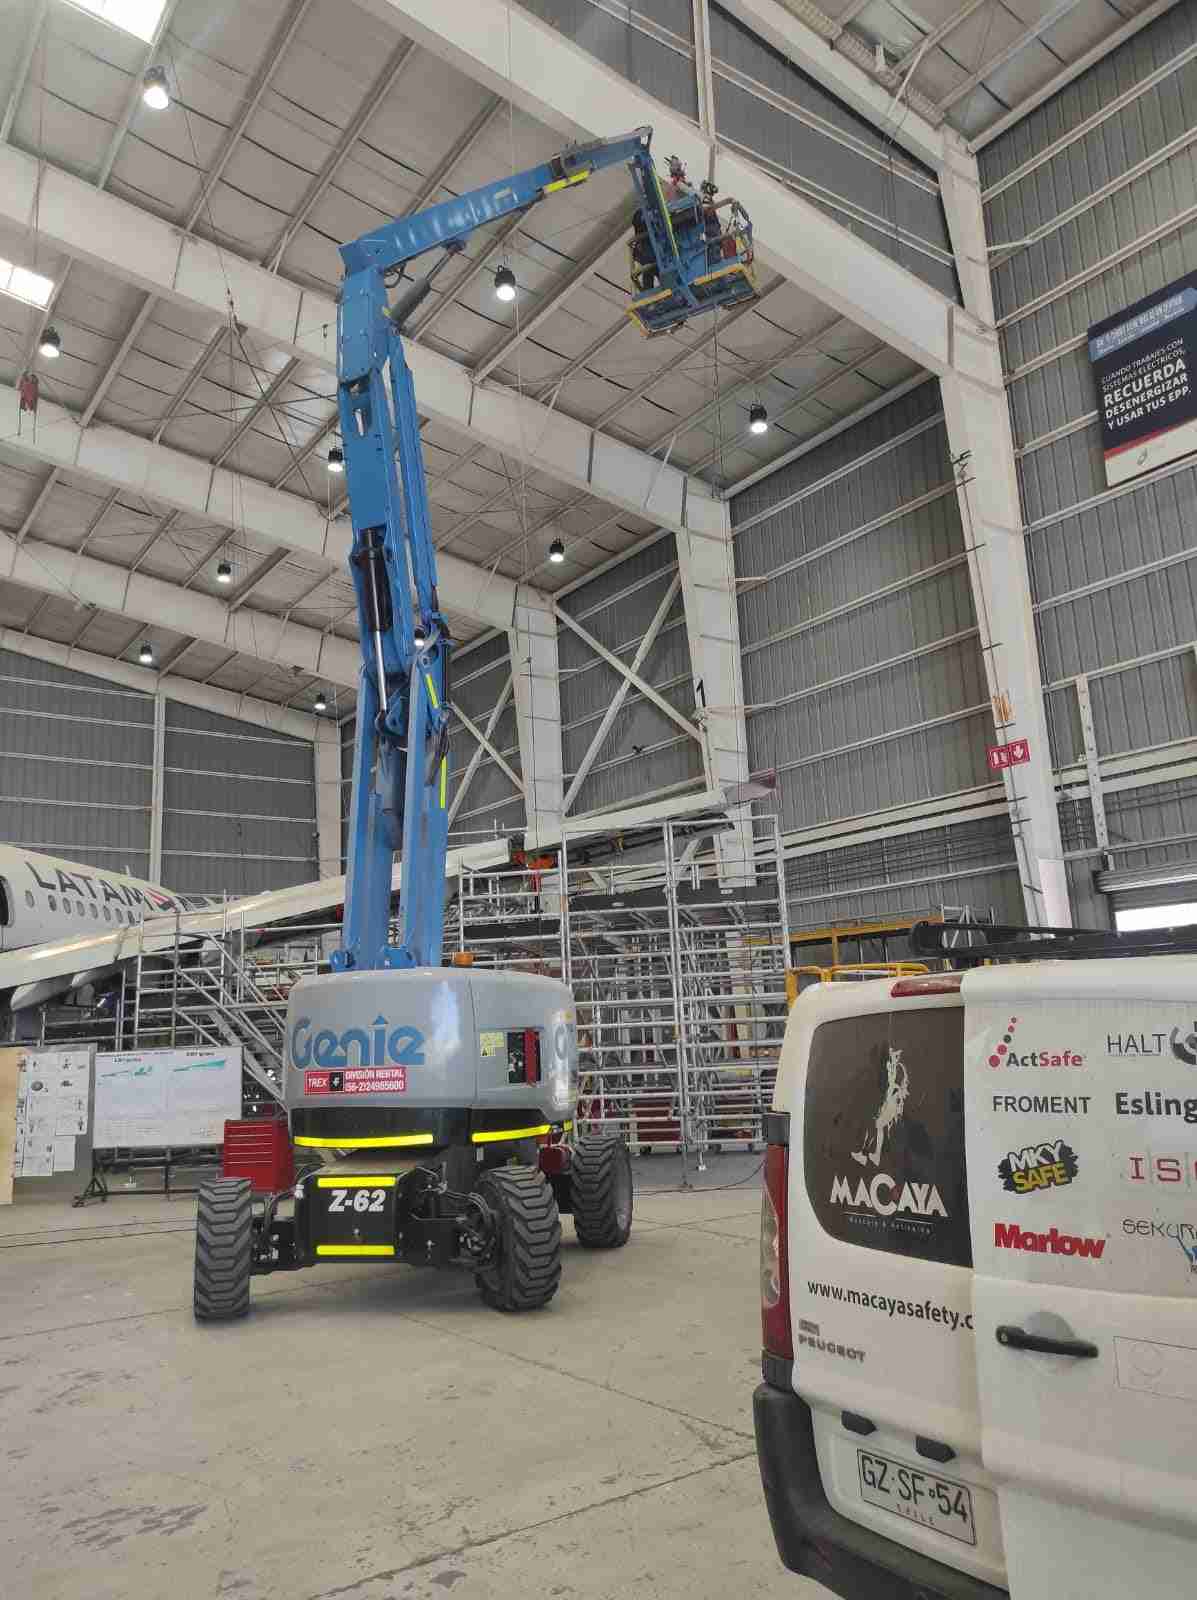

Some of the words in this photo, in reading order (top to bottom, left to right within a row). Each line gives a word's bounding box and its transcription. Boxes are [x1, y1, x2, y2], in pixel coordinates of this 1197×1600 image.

[1166, 337, 1184, 351] CON
[1104, 358, 1186, 407] RECUERDA
[1105, 373, 1188, 419] DESENERGIZAR
[1107, 420, 1114, 430] Y
[1116, 407, 1144, 426] USAR
[1145, 396, 1166, 413] TUS
[1167, 386, 1192, 402] EPP.
[25, 861, 154, 911] LATAM
[292, 1014, 425, 1069] Genie
[1107, 1033, 1167, 1053] HALT
[375, 1068, 404, 1079] RENTAL
[1006, 1050, 1083, 1067] ActSafe
[992, 1096, 1091, 1114] FROMENT
[1115, 1091, 1197, 1123] Esling
[1007, 1140, 1063, 1172] MKY
[1012, 1163, 1070, 1193] SAFE
[328, 1189, 386, 1212] Z-62
[829, 1173, 948, 1217] MACAYA
[993, 1223, 1106, 1259] Marlow
[807, 1280, 974, 1331] www.macayasafety.c
[798, 1333, 866, 1364] PEUGEOT
